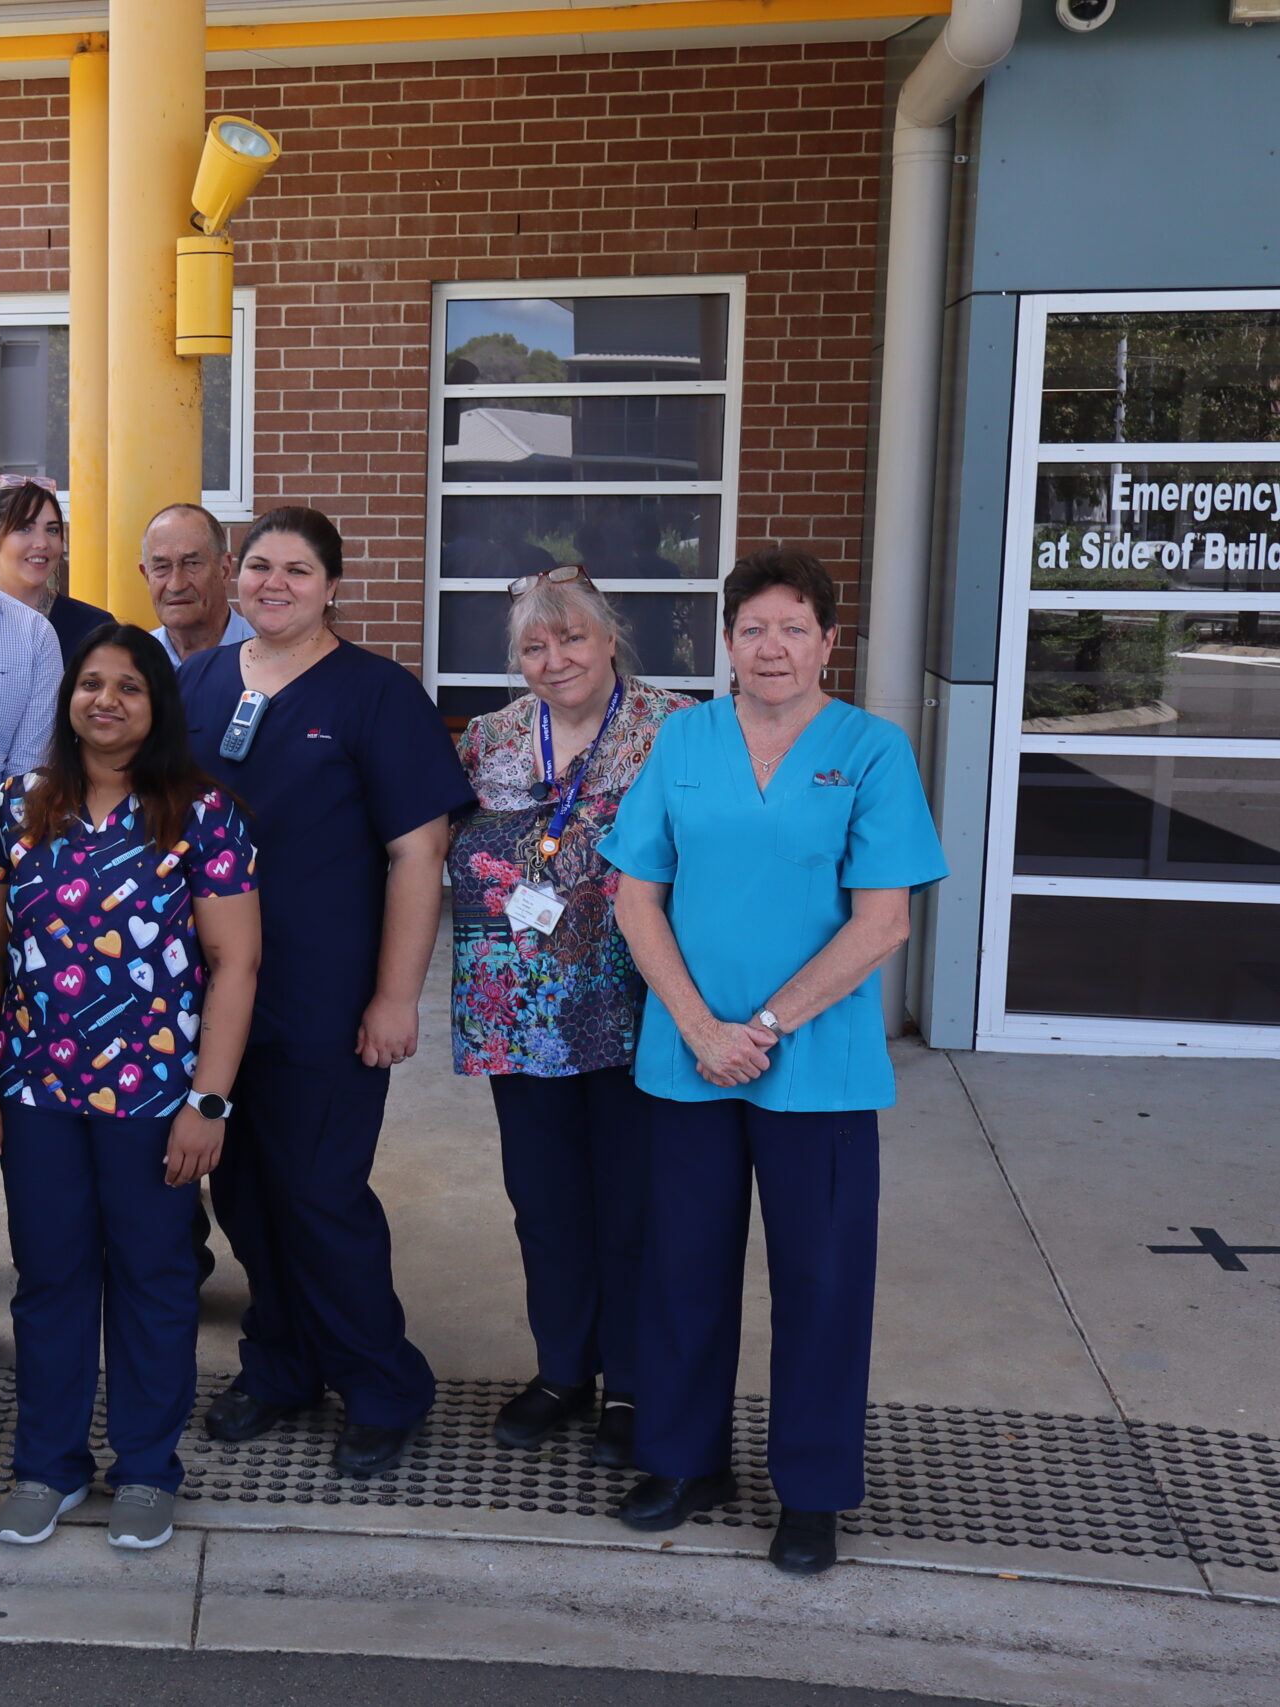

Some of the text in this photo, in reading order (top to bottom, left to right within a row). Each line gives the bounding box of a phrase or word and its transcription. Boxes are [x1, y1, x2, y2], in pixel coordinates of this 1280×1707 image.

[1037, 534, 1070, 569] at
[1080, 531, 1151, 570] Side
[1160, 531, 1194, 570] of
[541, 714, 550, 741] werfen
